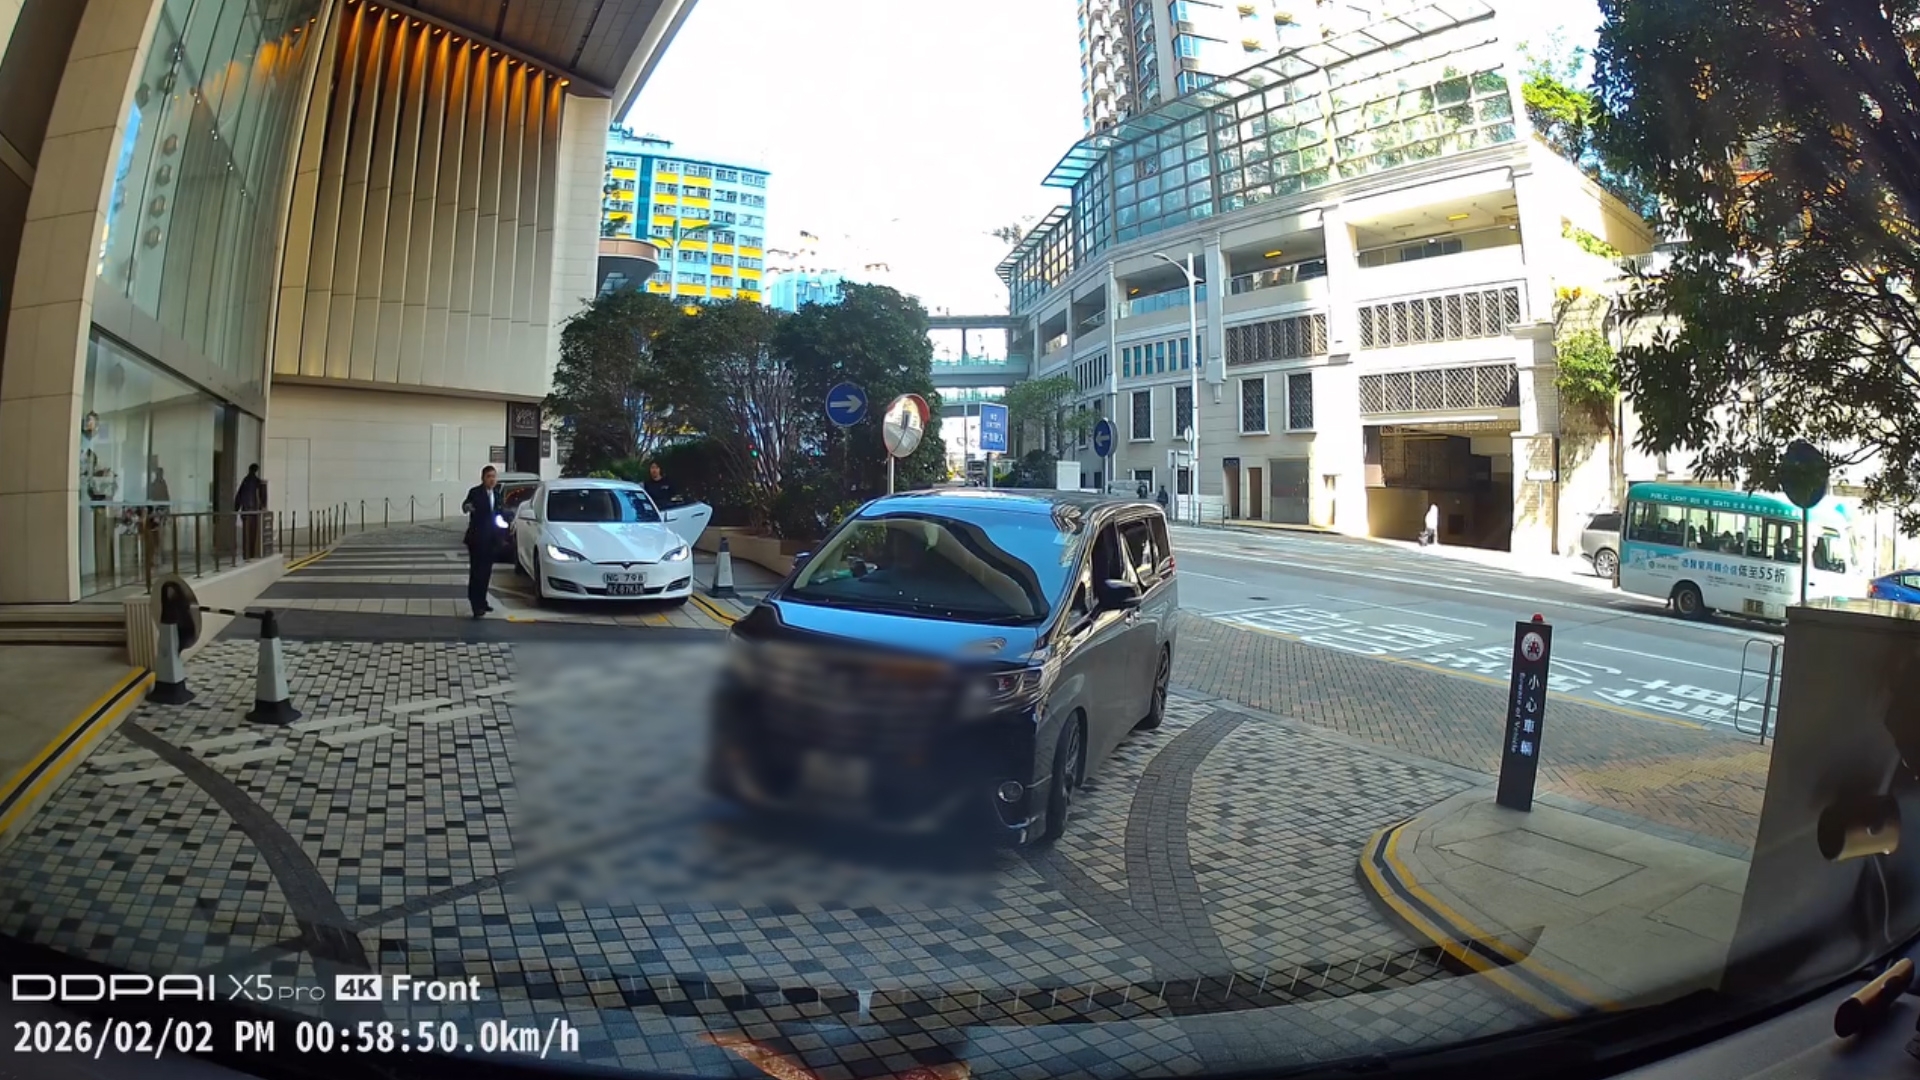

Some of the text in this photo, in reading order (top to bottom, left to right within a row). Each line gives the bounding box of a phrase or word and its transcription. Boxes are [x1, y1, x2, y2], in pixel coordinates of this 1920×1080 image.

[1650, 492, 1669, 500] PUBLIC
[1671, 495, 1688, 503] LIGHT
[1713, 500, 1730, 508] SEATS
[1209, 606, 1364, 634] KEEP
[1300, 623, 1476, 655] CLEAR
[1520, 673, 1540, 757] 小心車輛
